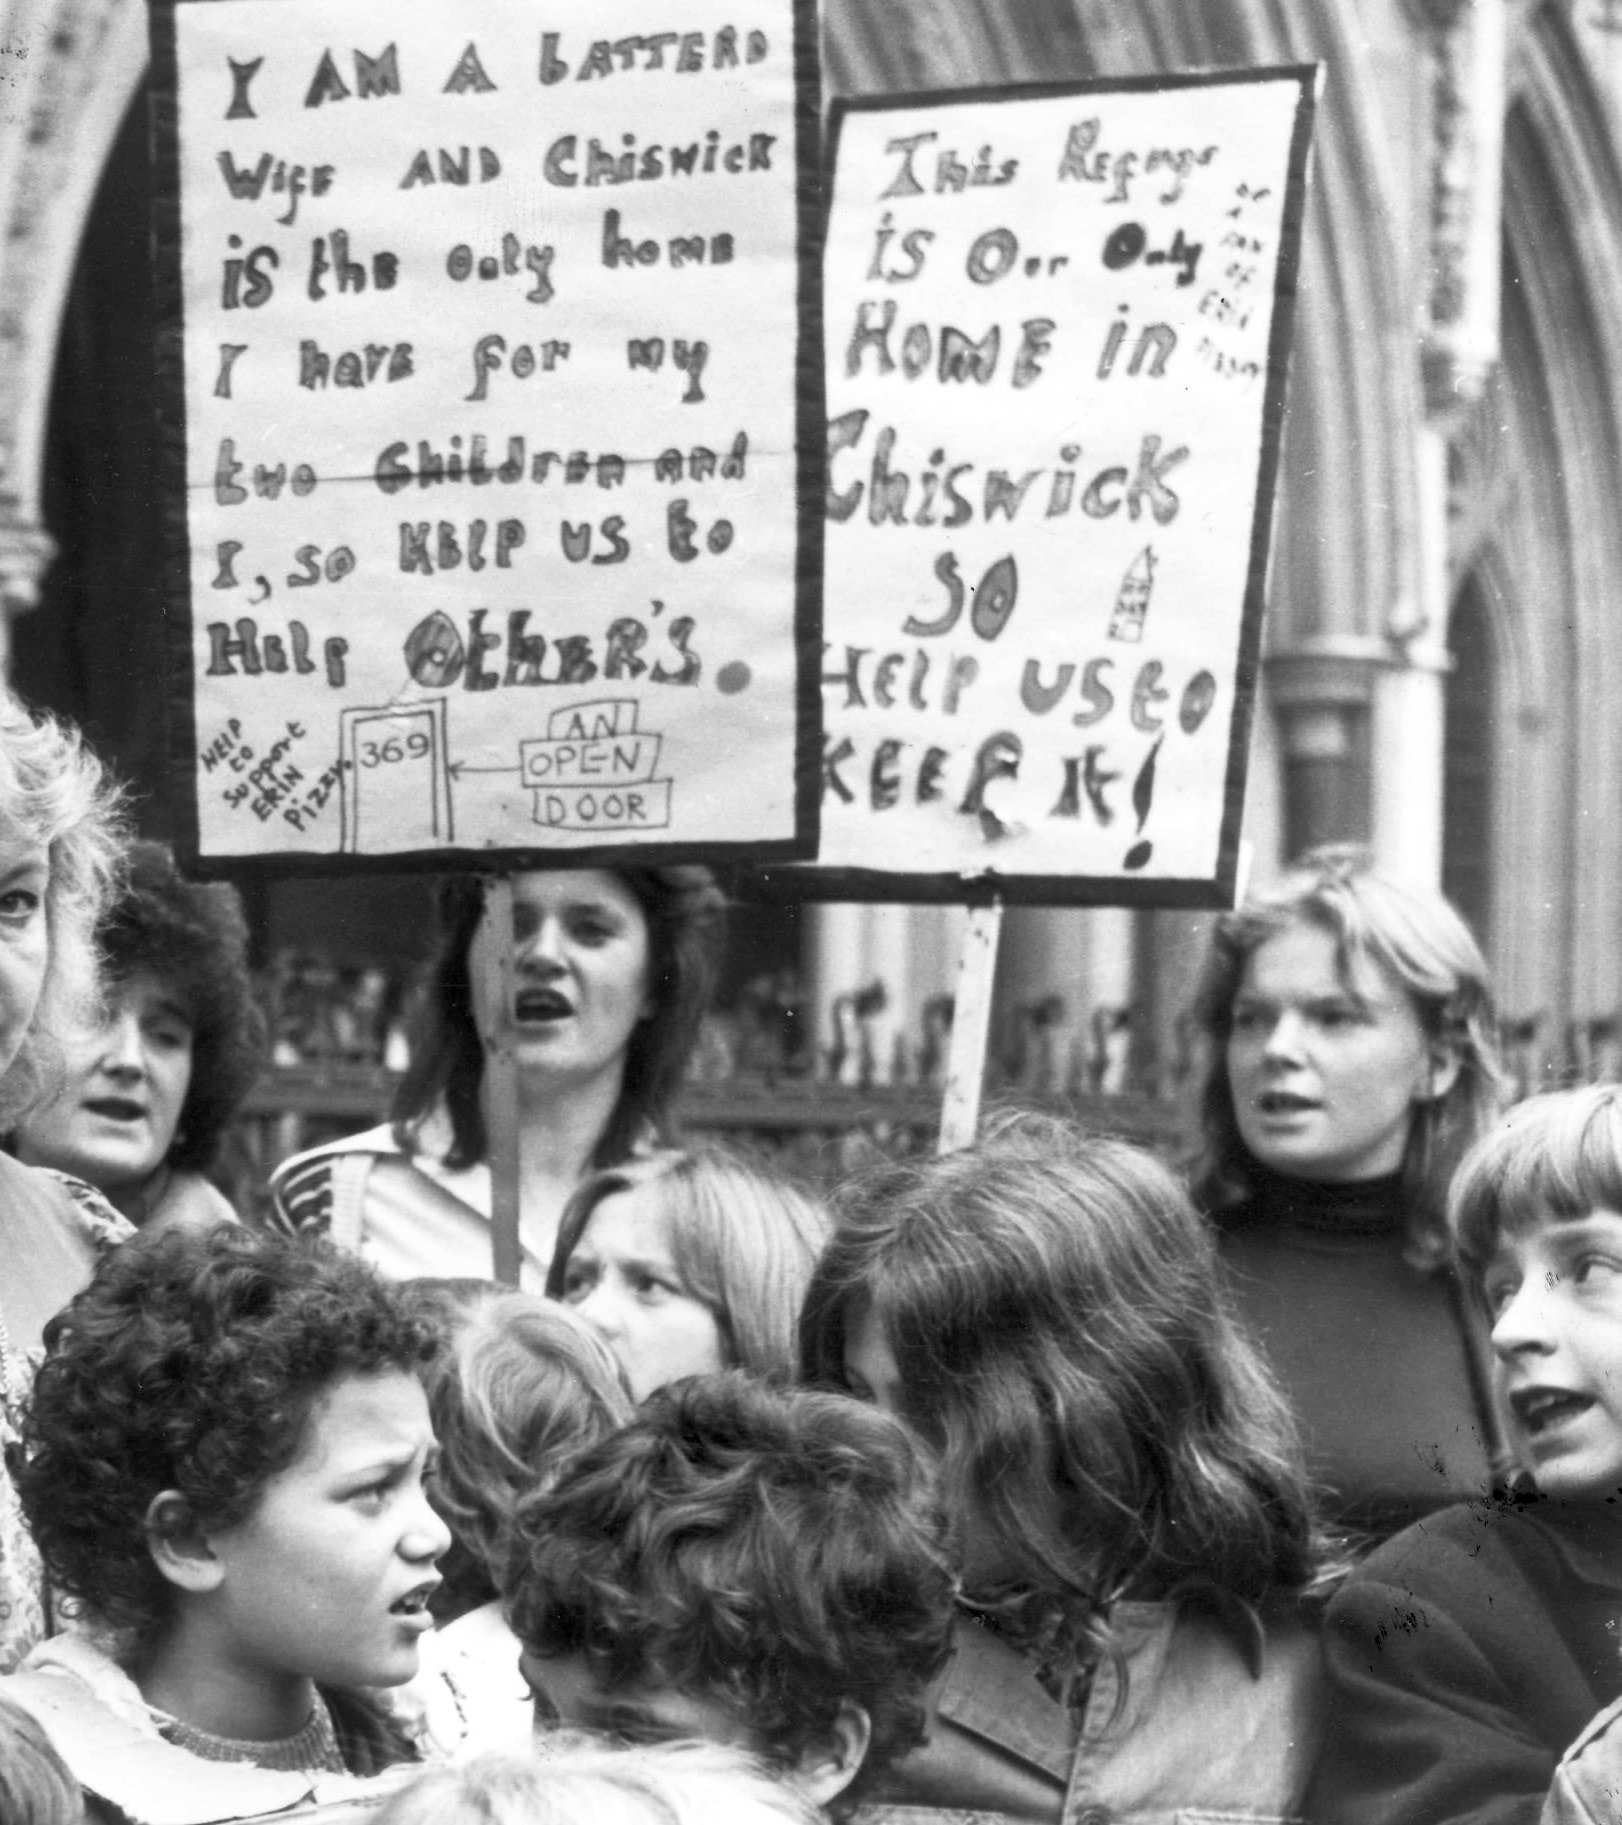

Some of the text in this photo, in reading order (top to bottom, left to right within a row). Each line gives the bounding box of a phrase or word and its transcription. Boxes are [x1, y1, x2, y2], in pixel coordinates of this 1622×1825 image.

[224, 55, 265, 120] I
[304, 42, 402, 108] AM
[442, 41, 498, 94] A
[398, 146, 502, 190] AND
[844, 299, 1057, 389] HOME
[1097, 303, 1178, 380] in
[361, 732, 430, 769] 369
[529, 741, 642, 777] OPEN
[545, 792, 647, 826] DOOR
